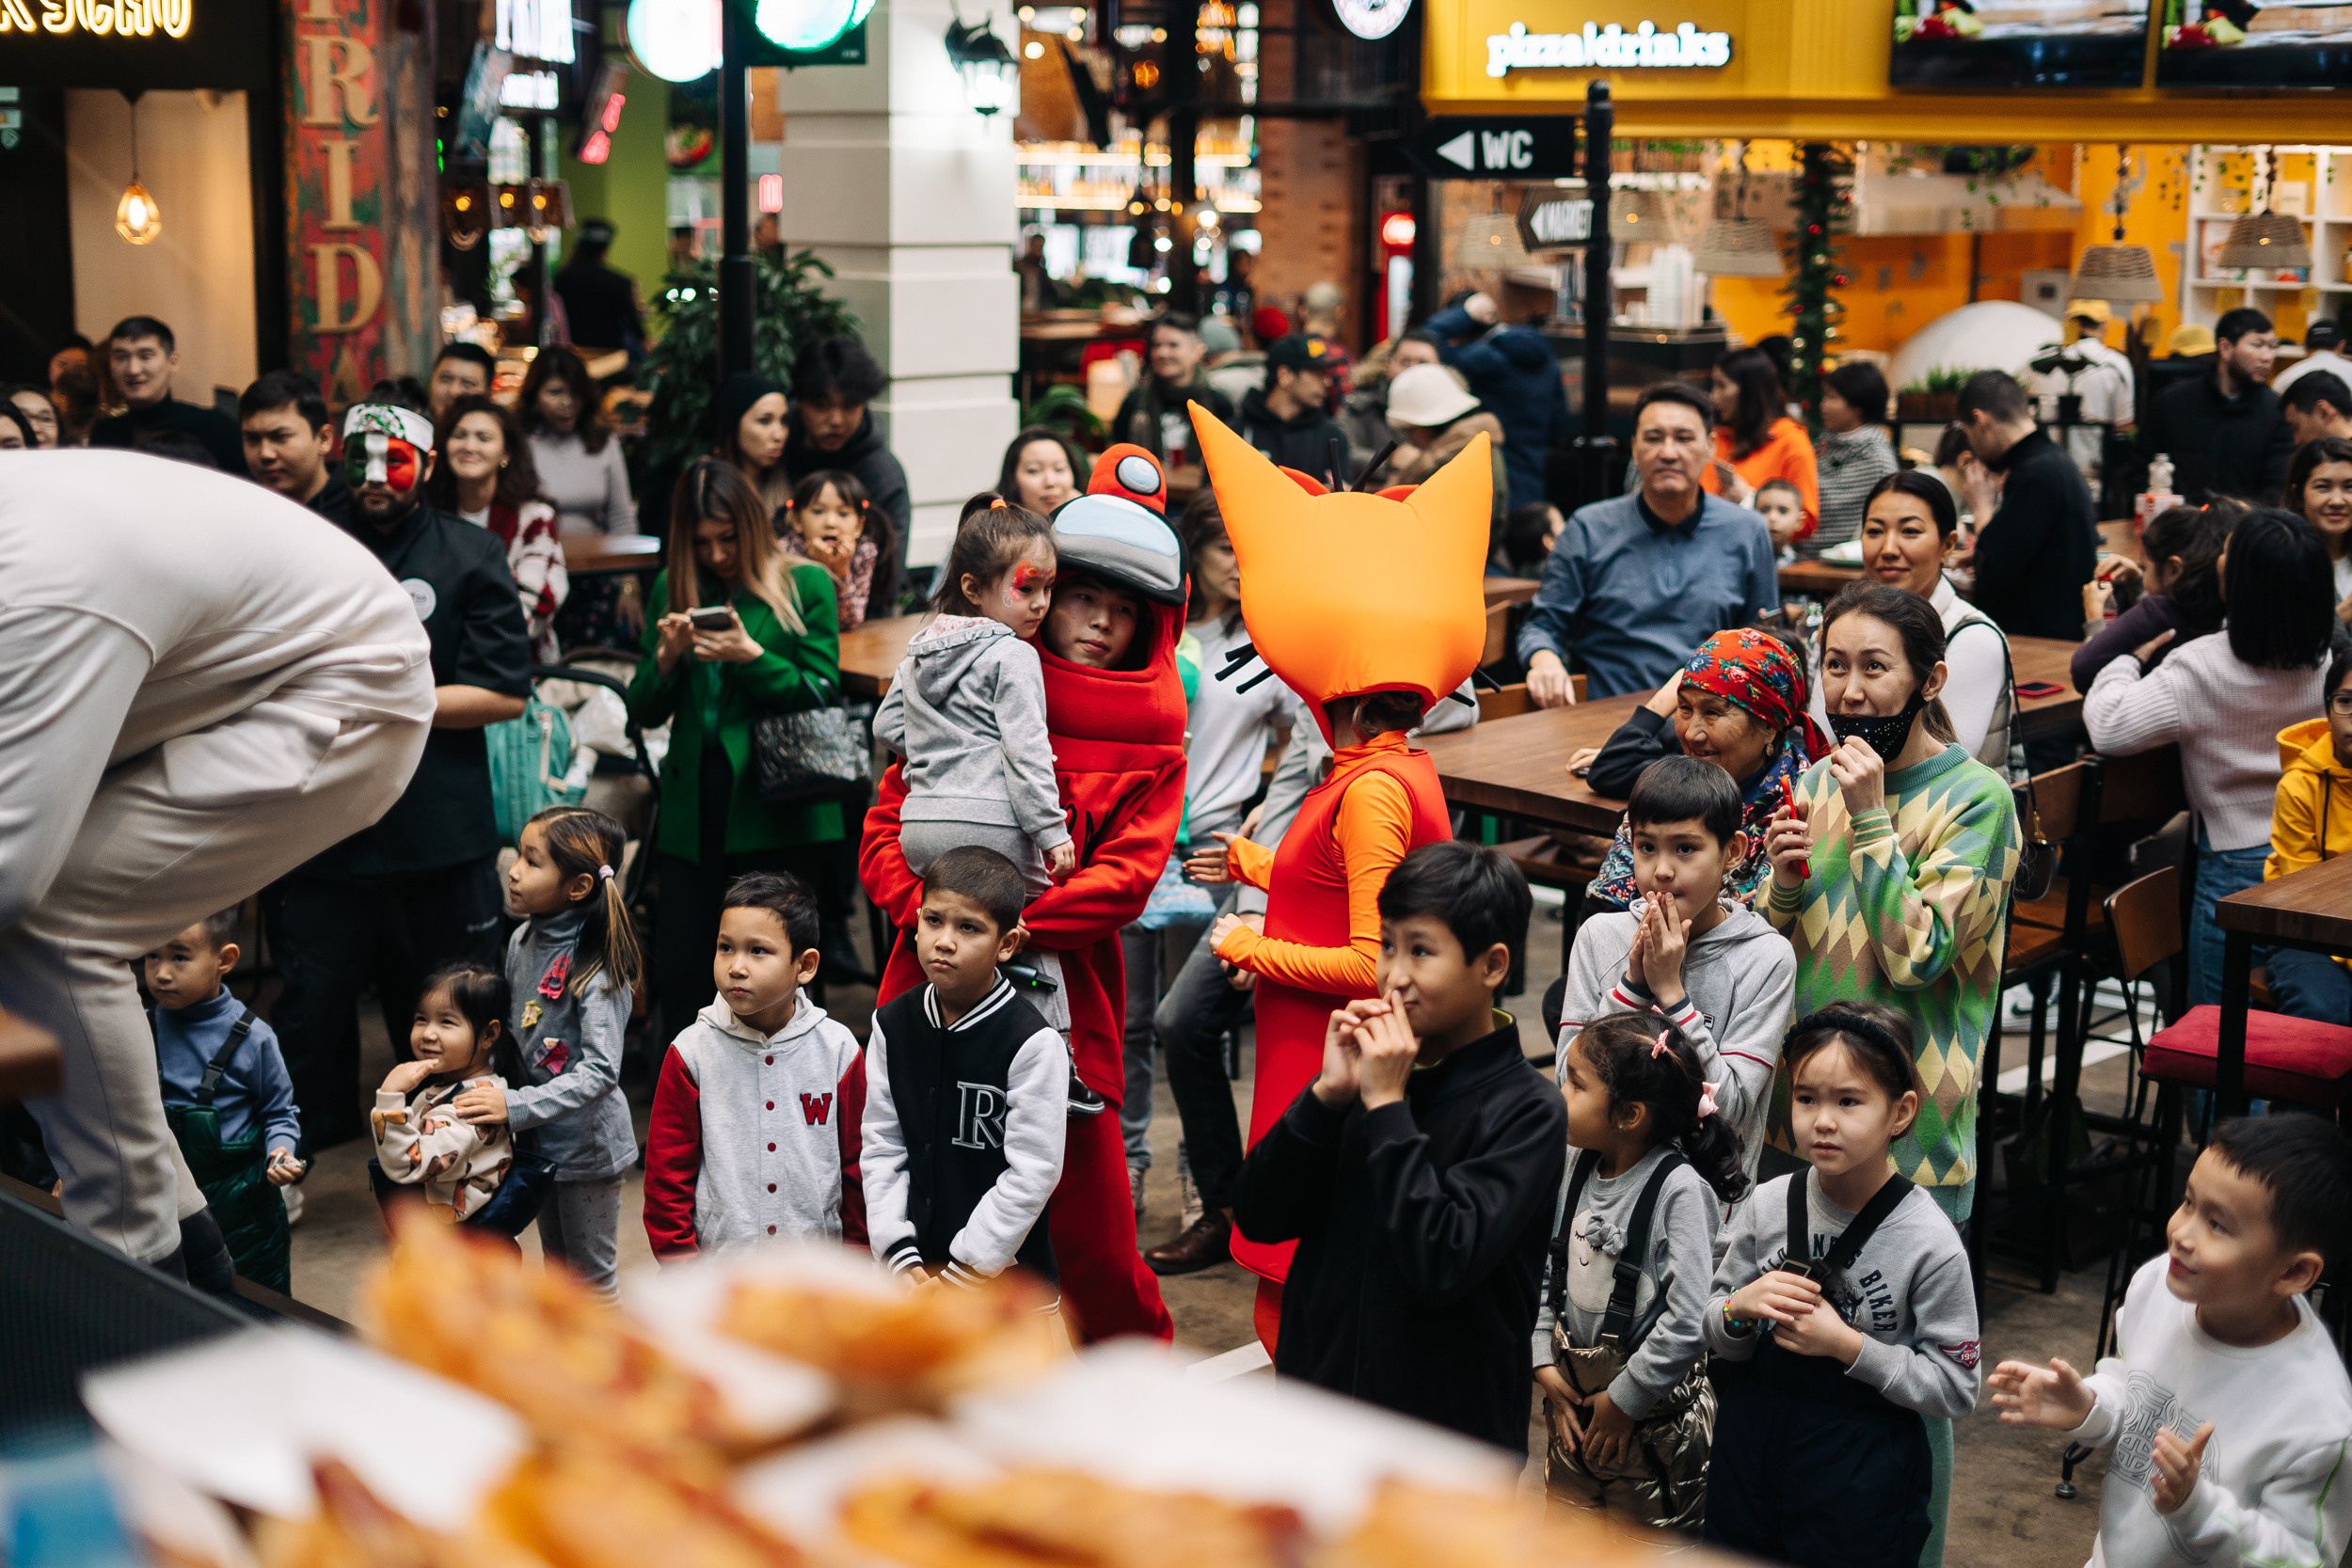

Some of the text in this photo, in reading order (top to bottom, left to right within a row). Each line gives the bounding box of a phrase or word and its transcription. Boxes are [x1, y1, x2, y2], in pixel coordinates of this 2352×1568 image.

[1481, 130, 1534, 169] WC
[297, 0, 384, 412] RIDA
[800, 1093, 833, 1125] W
[952, 1081, 1007, 1149] R
[1859, 1269, 1898, 1331] BIKER
